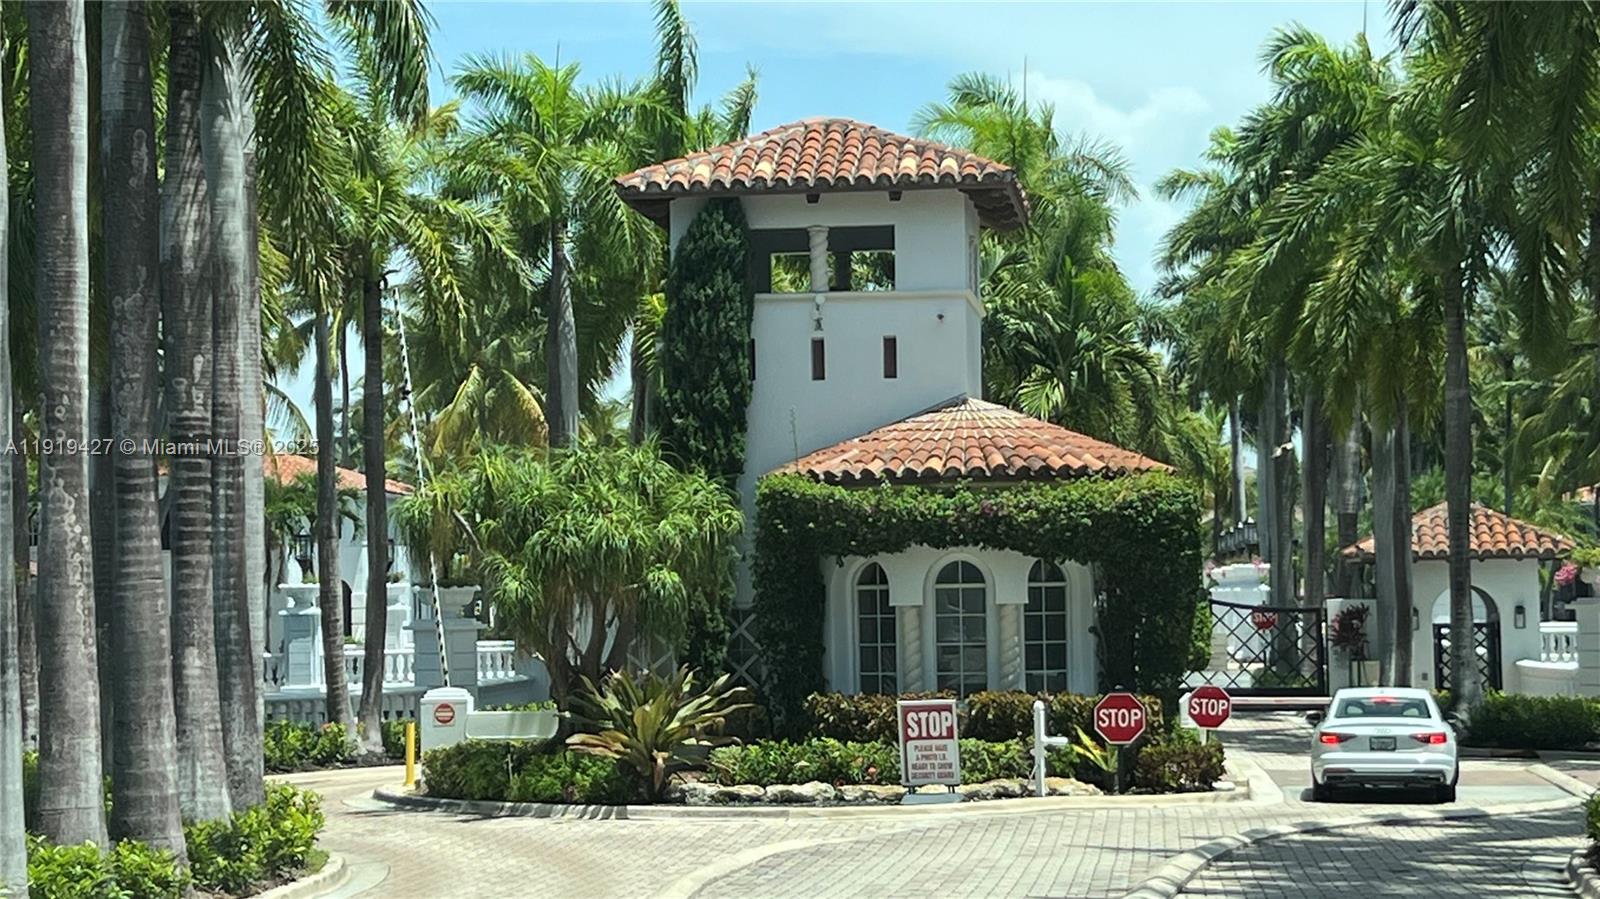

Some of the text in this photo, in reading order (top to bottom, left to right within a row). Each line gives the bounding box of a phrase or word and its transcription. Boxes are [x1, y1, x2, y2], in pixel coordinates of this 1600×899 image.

[1190, 698, 1228, 716] STOP
[1098, 708, 1142, 727] STOP
[906, 711, 953, 738] STOP
[914, 744, 933, 752] PLEASE
[921, 753, 937, 761] PHOTO
[929, 762, 936, 770] TO
[937, 762, 953, 770] SHOW
